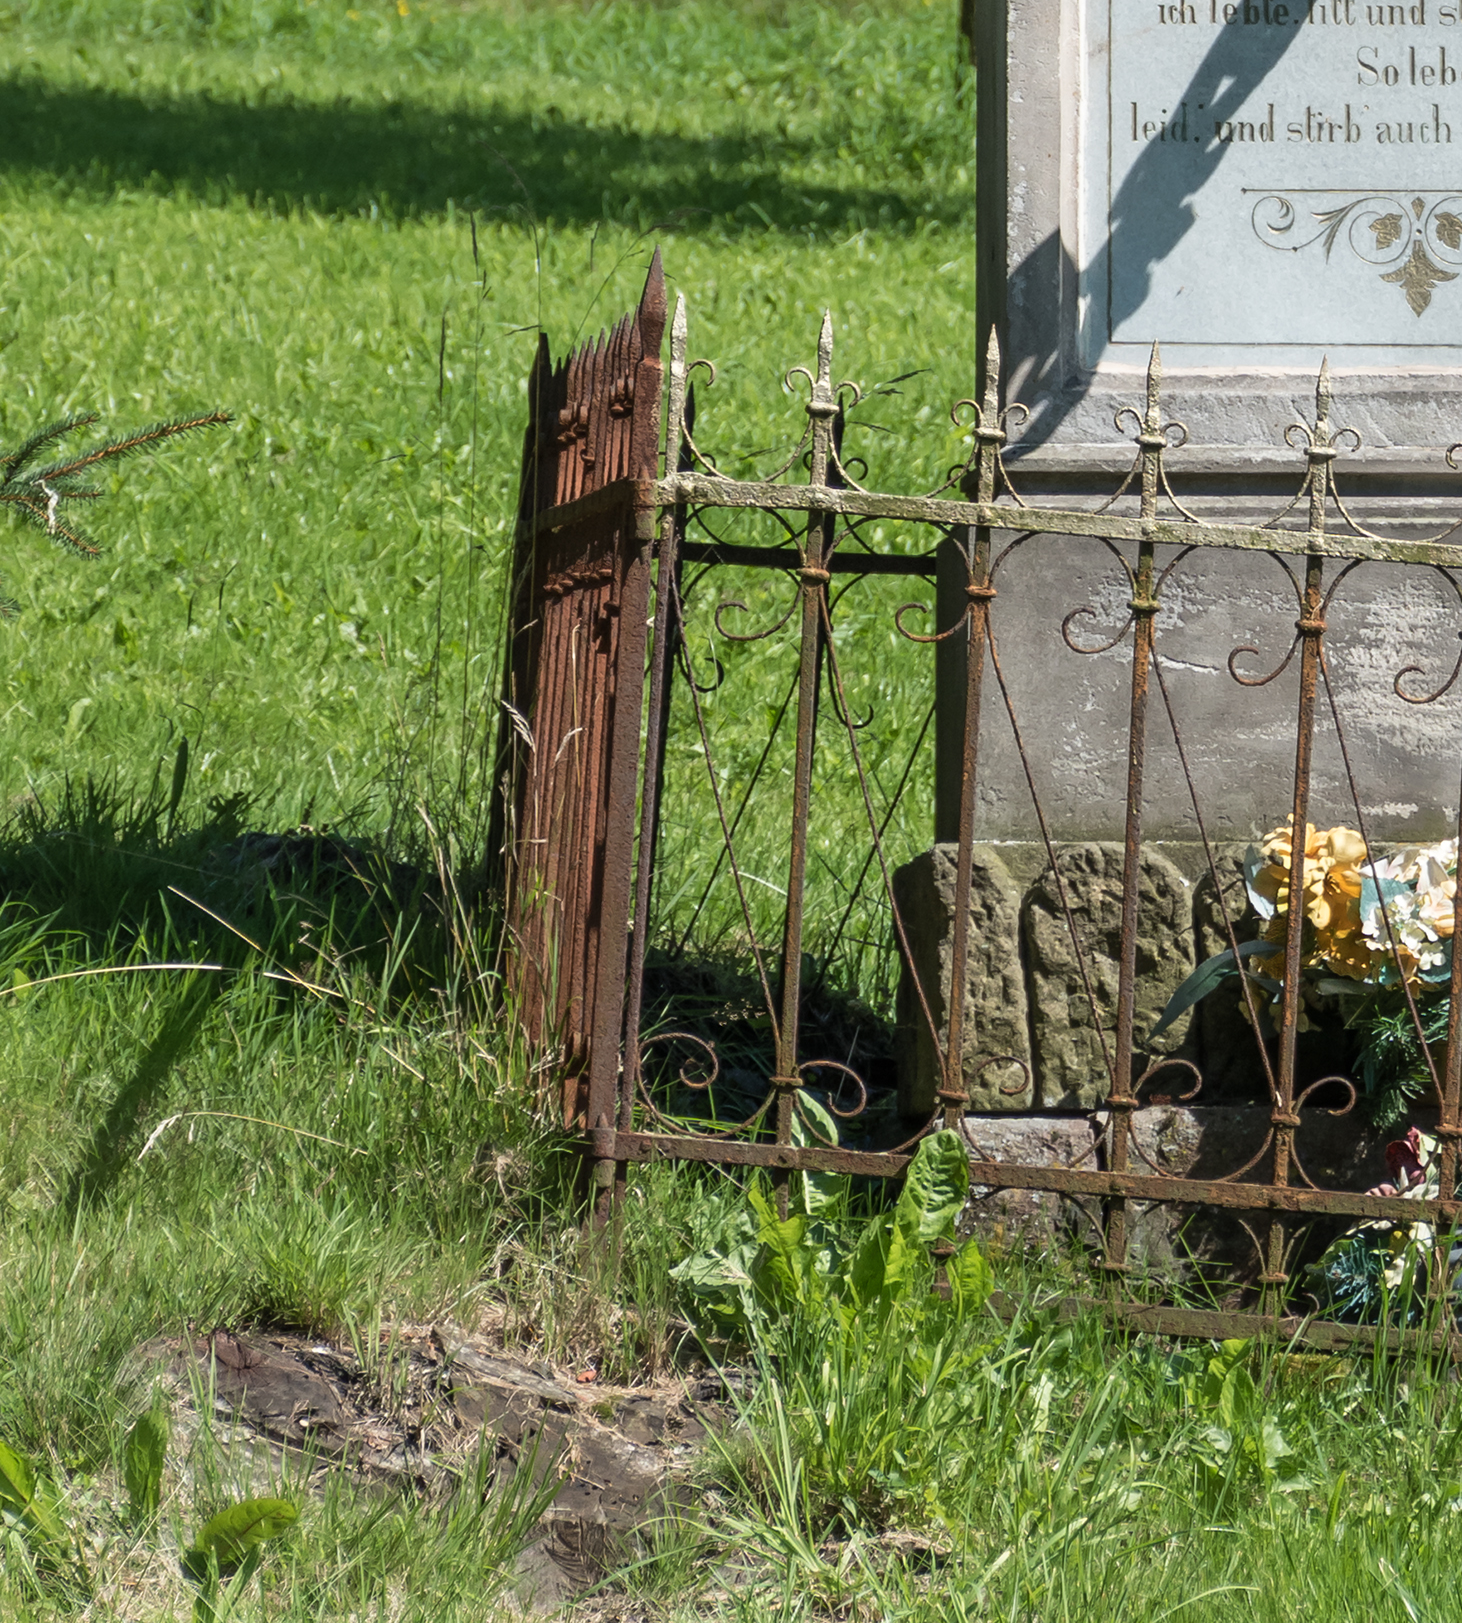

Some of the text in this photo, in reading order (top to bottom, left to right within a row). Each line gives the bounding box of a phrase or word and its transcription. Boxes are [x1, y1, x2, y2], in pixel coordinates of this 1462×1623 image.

[1357, 46, 1399, 87] So
[1214, 103, 1275, 143] und
[1376, 104, 1452, 144] auch
